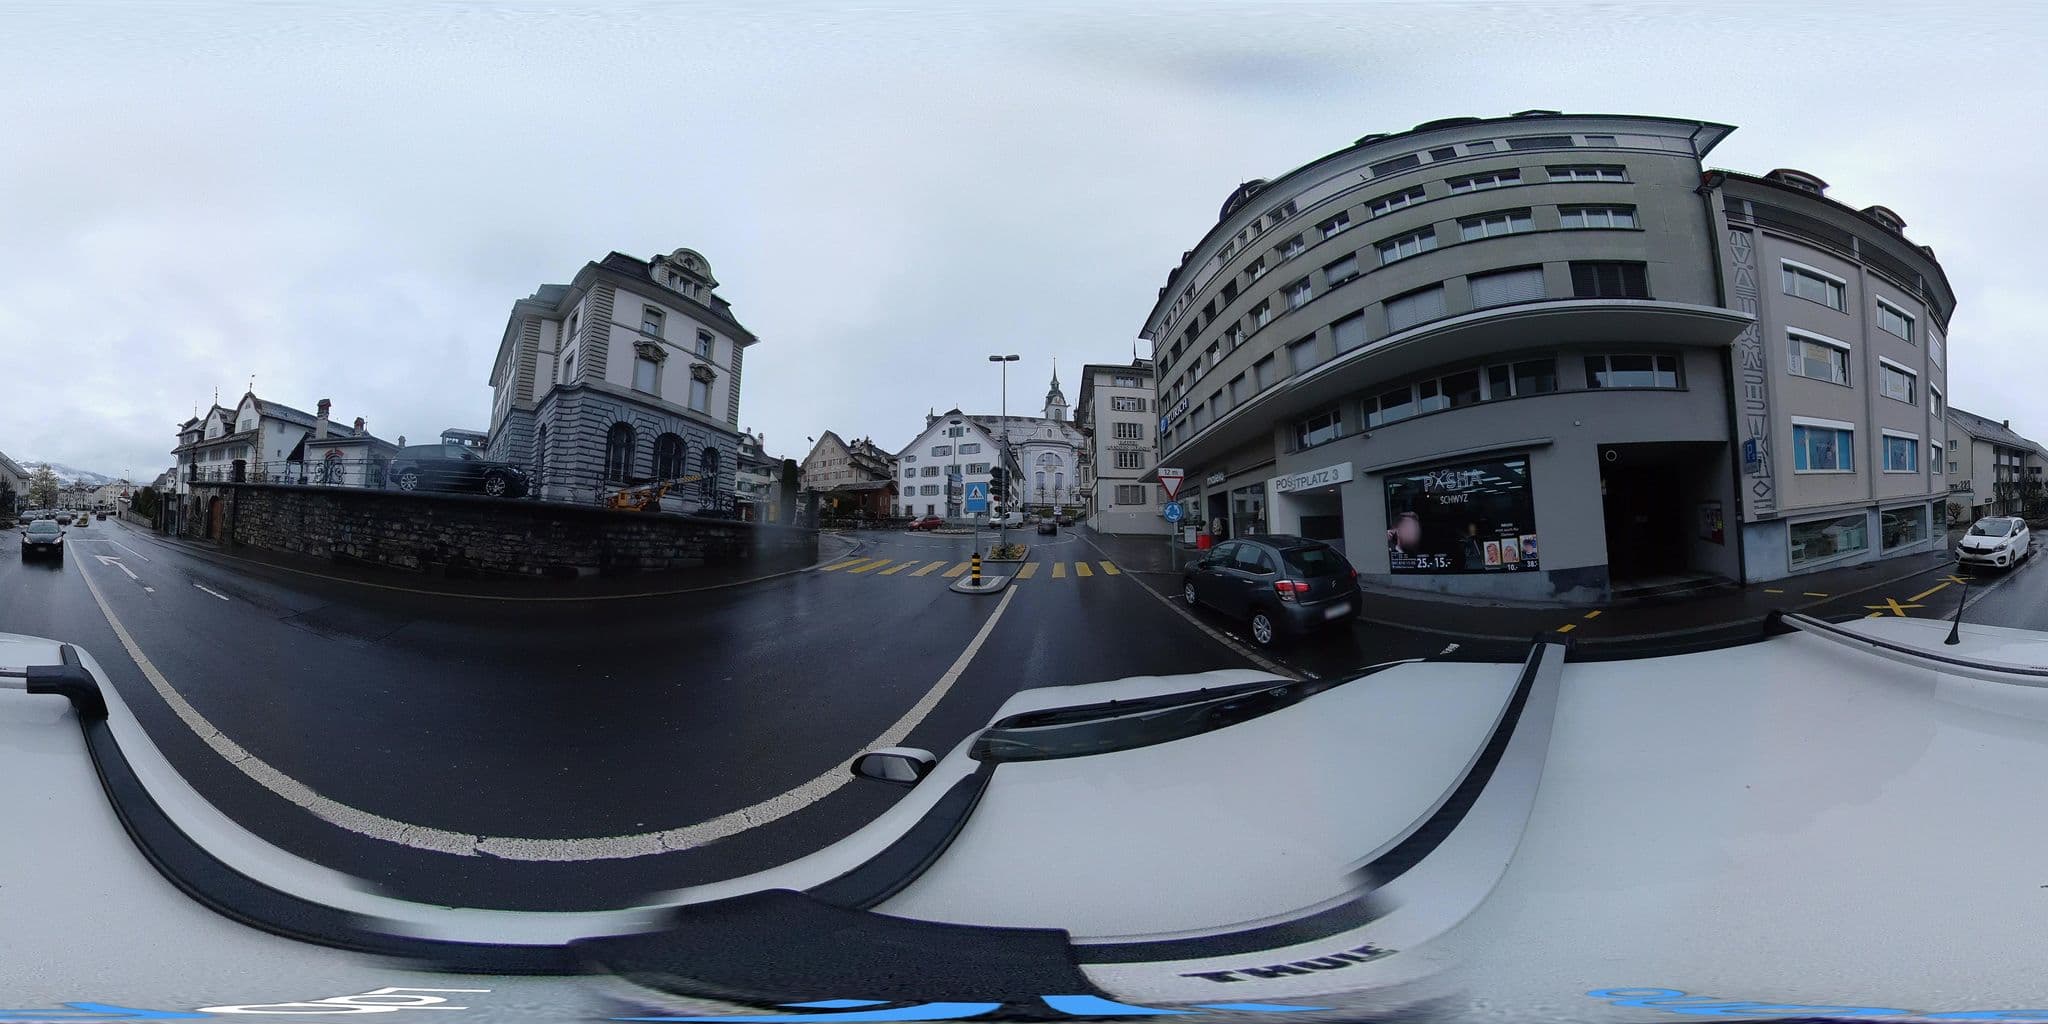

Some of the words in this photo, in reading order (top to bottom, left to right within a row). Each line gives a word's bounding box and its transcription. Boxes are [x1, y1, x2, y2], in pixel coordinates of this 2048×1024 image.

[1332, 468, 1339, 481] 3
[1440, 493, 1469, 505] SCHWYZ
[1178, 942, 1400, 983] THULE
